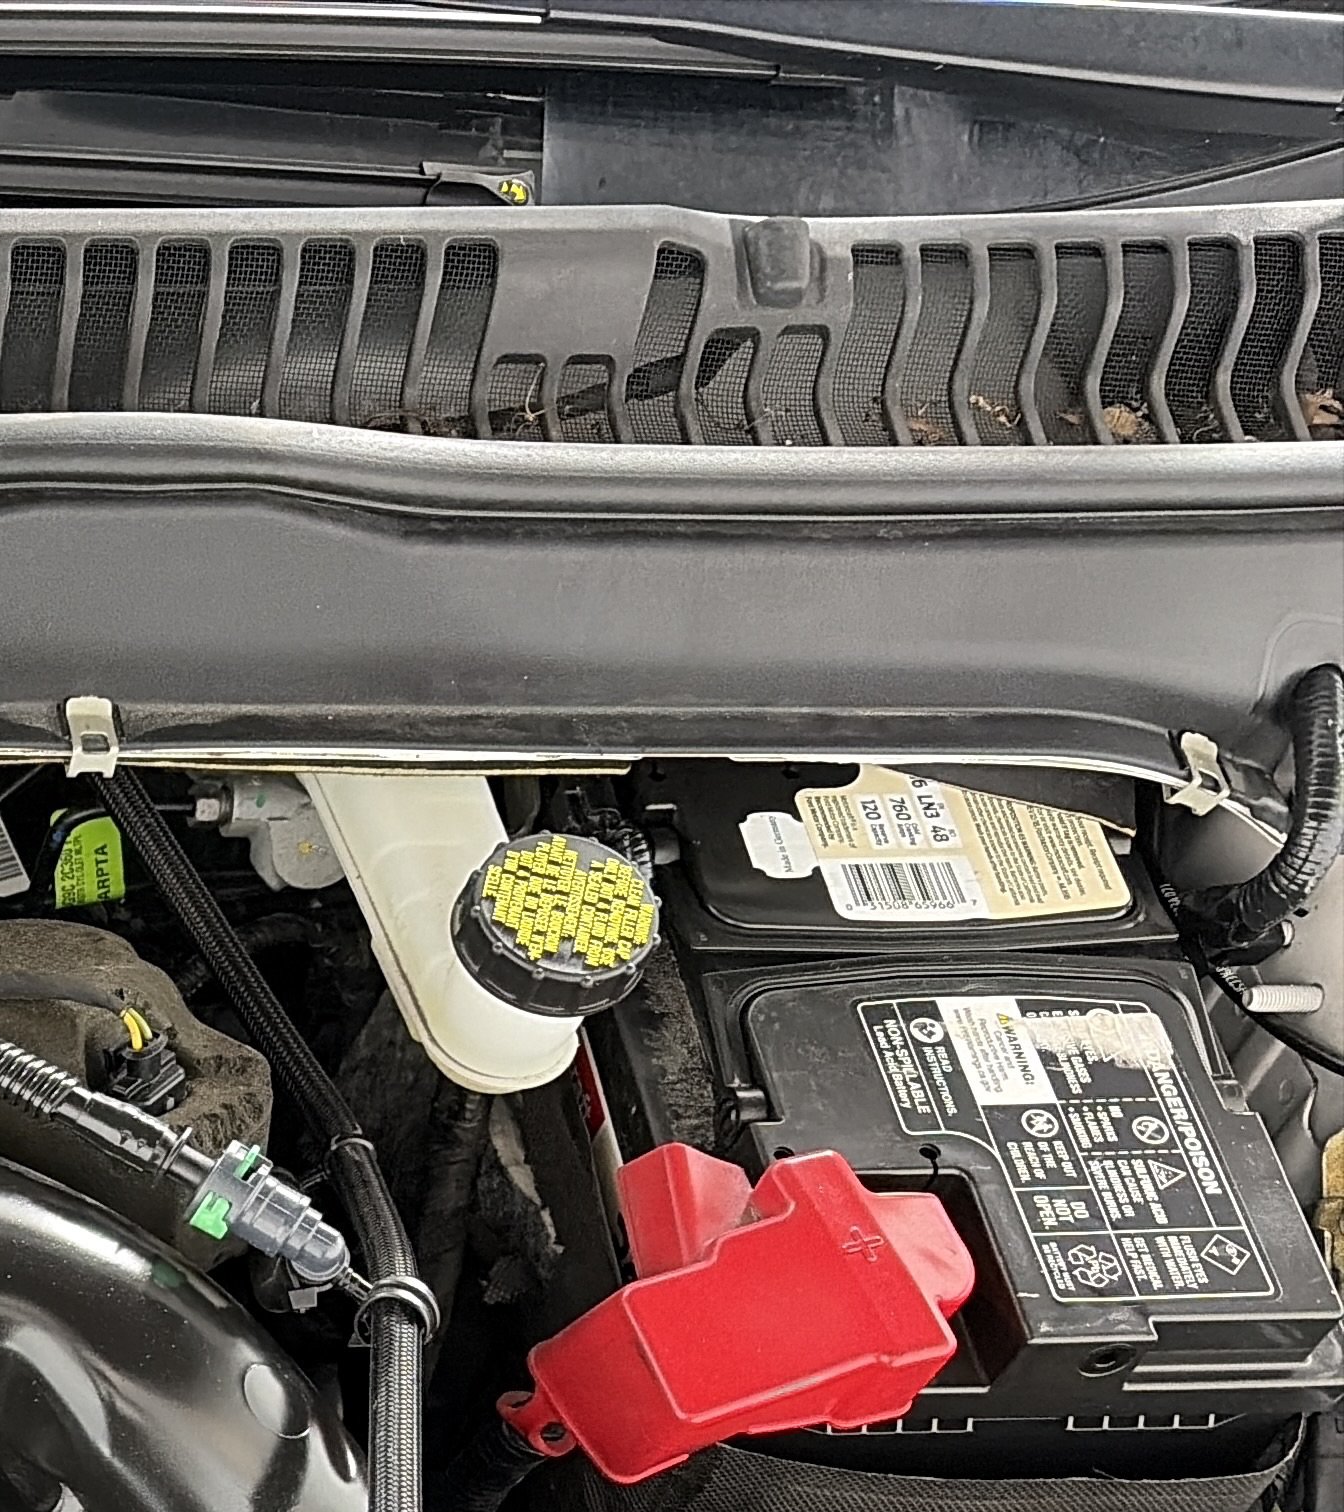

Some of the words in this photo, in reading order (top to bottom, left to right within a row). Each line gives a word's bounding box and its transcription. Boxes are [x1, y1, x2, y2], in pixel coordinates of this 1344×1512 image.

[860, 799, 881, 820] 120
[888, 797, 911, 821] 760
[916, 794, 940, 818] LN3
[929, 824, 949, 843] 48
[590, 859, 605, 869] A
[614, 939, 633, 960] CAP
[872, 1025, 890, 1048] Lead
[882, 1050, 900, 1072] Acid
[891, 1073, 912, 1107] Battery
[882, 1019, 931, 1113] NON-SPILLABLE
[934, 1045, 953, 1072] READ
[922, 1046, 958, 1117] INSTRUCTIONS.
[1032, 1195, 1058, 1229] OPEN.
[1051, 1198, 1074, 1222] NOT
[1069, 1200, 1089, 1219] DO
